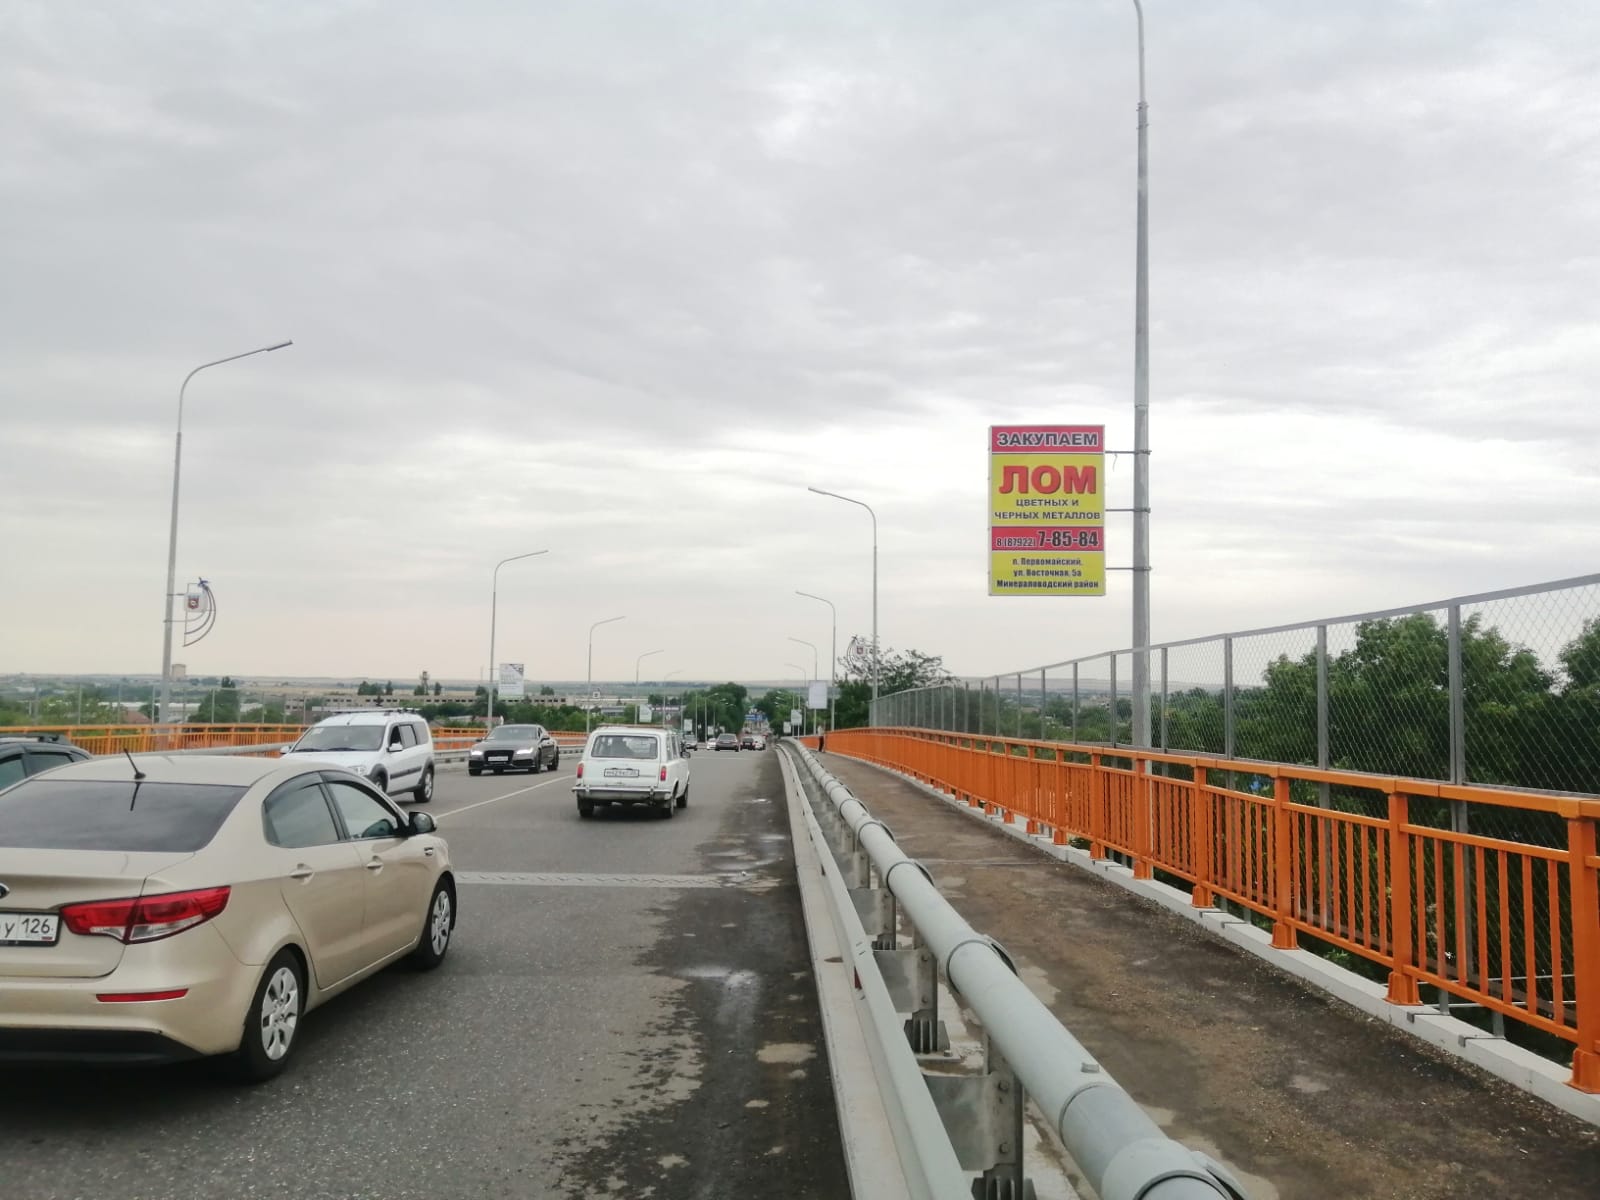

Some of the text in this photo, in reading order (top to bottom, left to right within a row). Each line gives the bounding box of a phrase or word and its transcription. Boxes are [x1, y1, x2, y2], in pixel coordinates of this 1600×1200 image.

[998, 432, 1098, 446] ЗАКУПАЕМ
[998, 465, 1096, 494] ЛОМ
[1016, 499, 1068, 507] ЦВЕТНЫХ
[995, 511, 1100, 519] ЧЕРНЫХ МЕТАЛЛОВ
[996, 530, 1098, 547] 8 (87922) 7-85-84
[1074, 580, 1099, 588] район
[21, 918, 50, 934] 126
